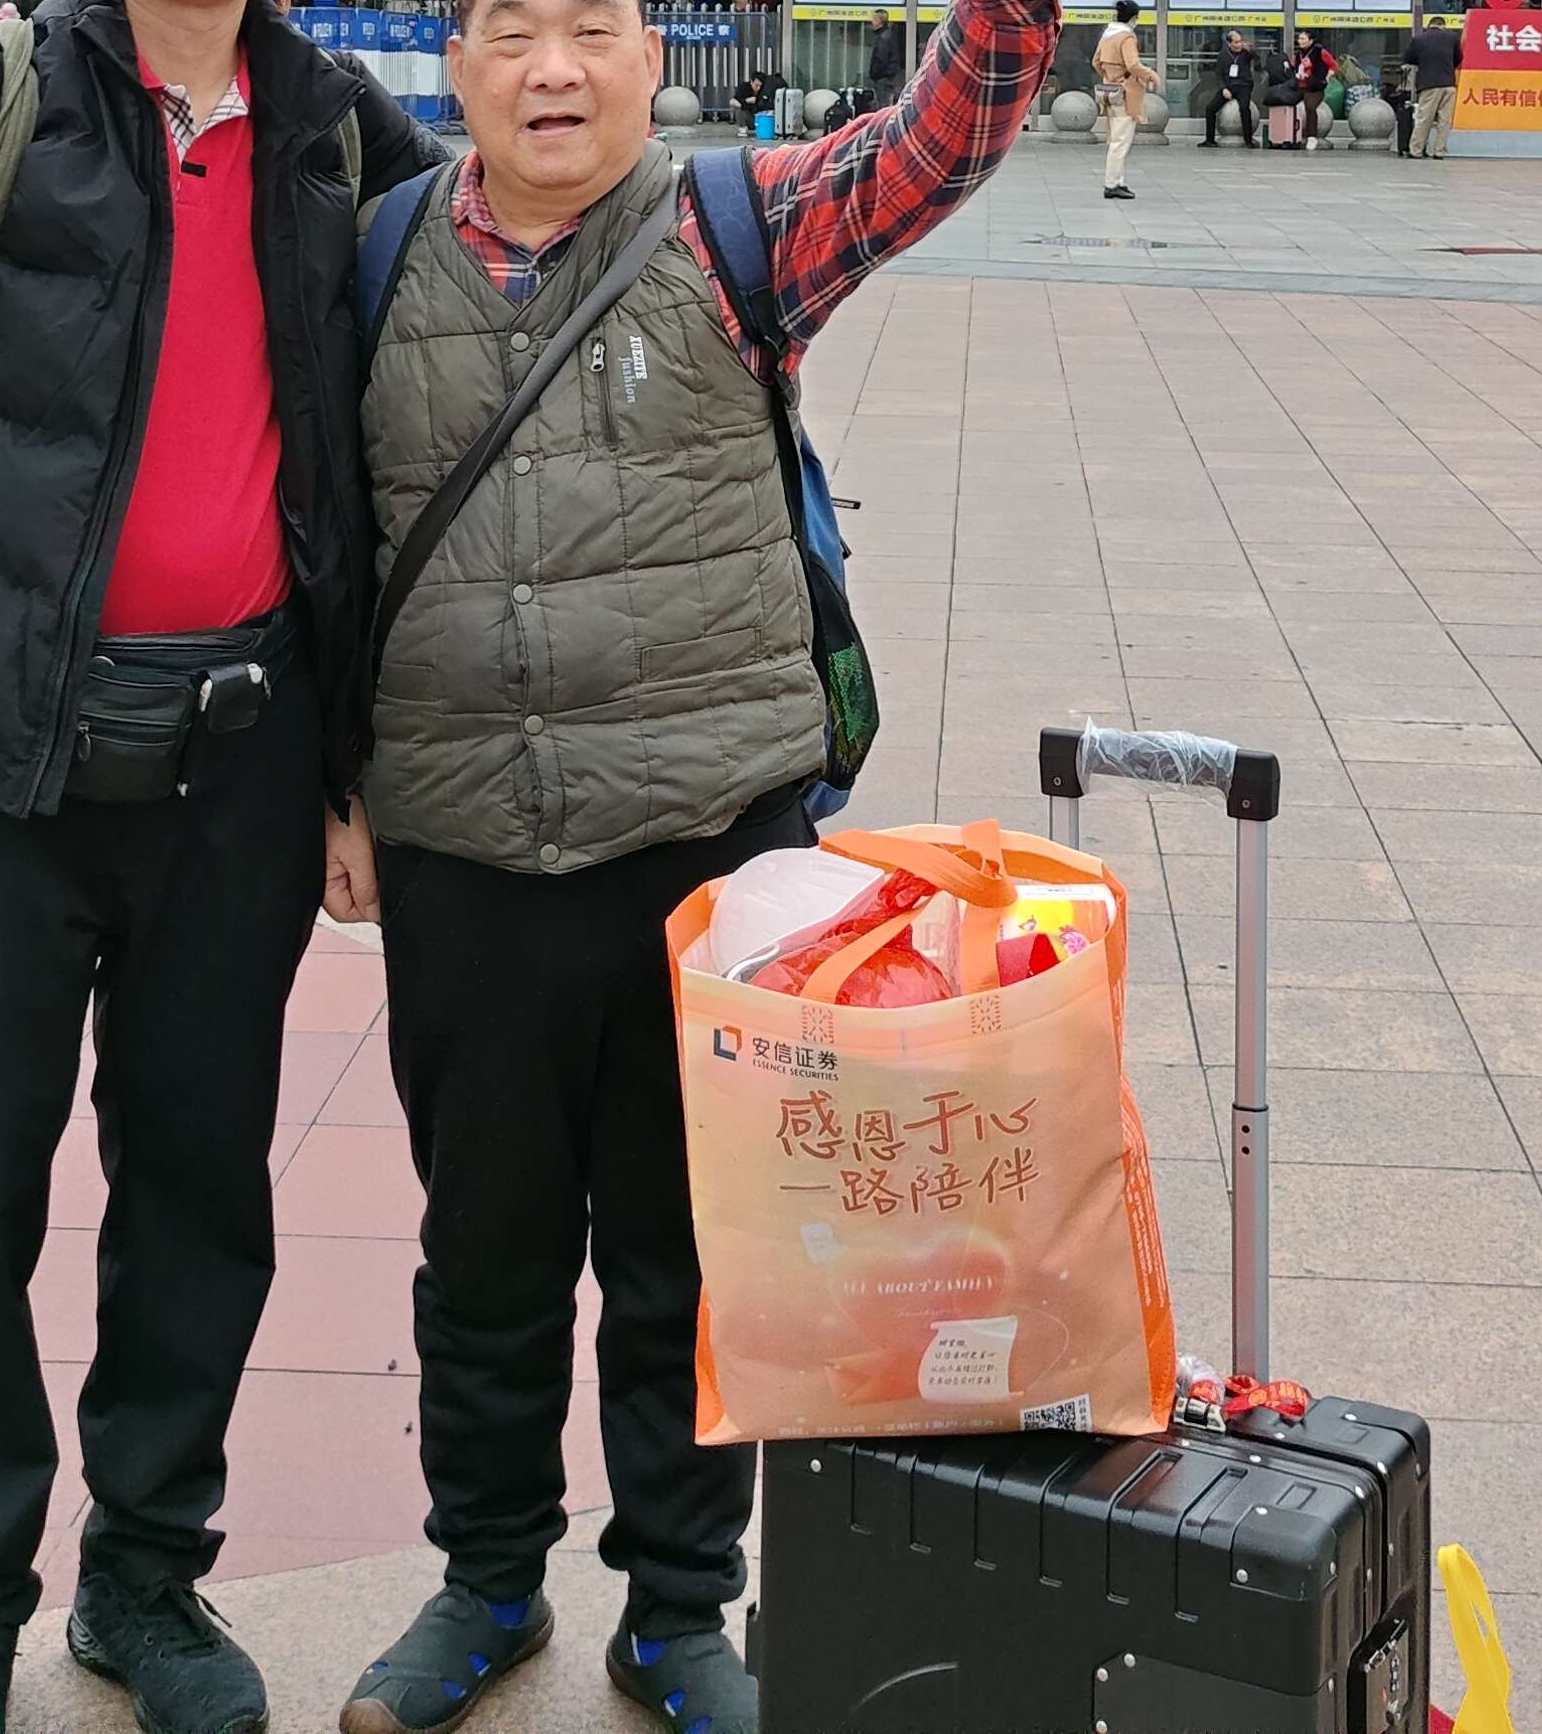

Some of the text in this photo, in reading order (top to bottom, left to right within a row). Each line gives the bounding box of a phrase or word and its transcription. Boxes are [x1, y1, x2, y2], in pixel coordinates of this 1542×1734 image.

[670, 24, 715, 36] POLICE
[752, 1037, 839, 1071] 安信证券
[752, 1059, 840, 1082] ESSENCE SECURITIES
[775, 1089, 1037, 1163] 感恩于心
[777, 1147, 1042, 1217] 一路陪伴
